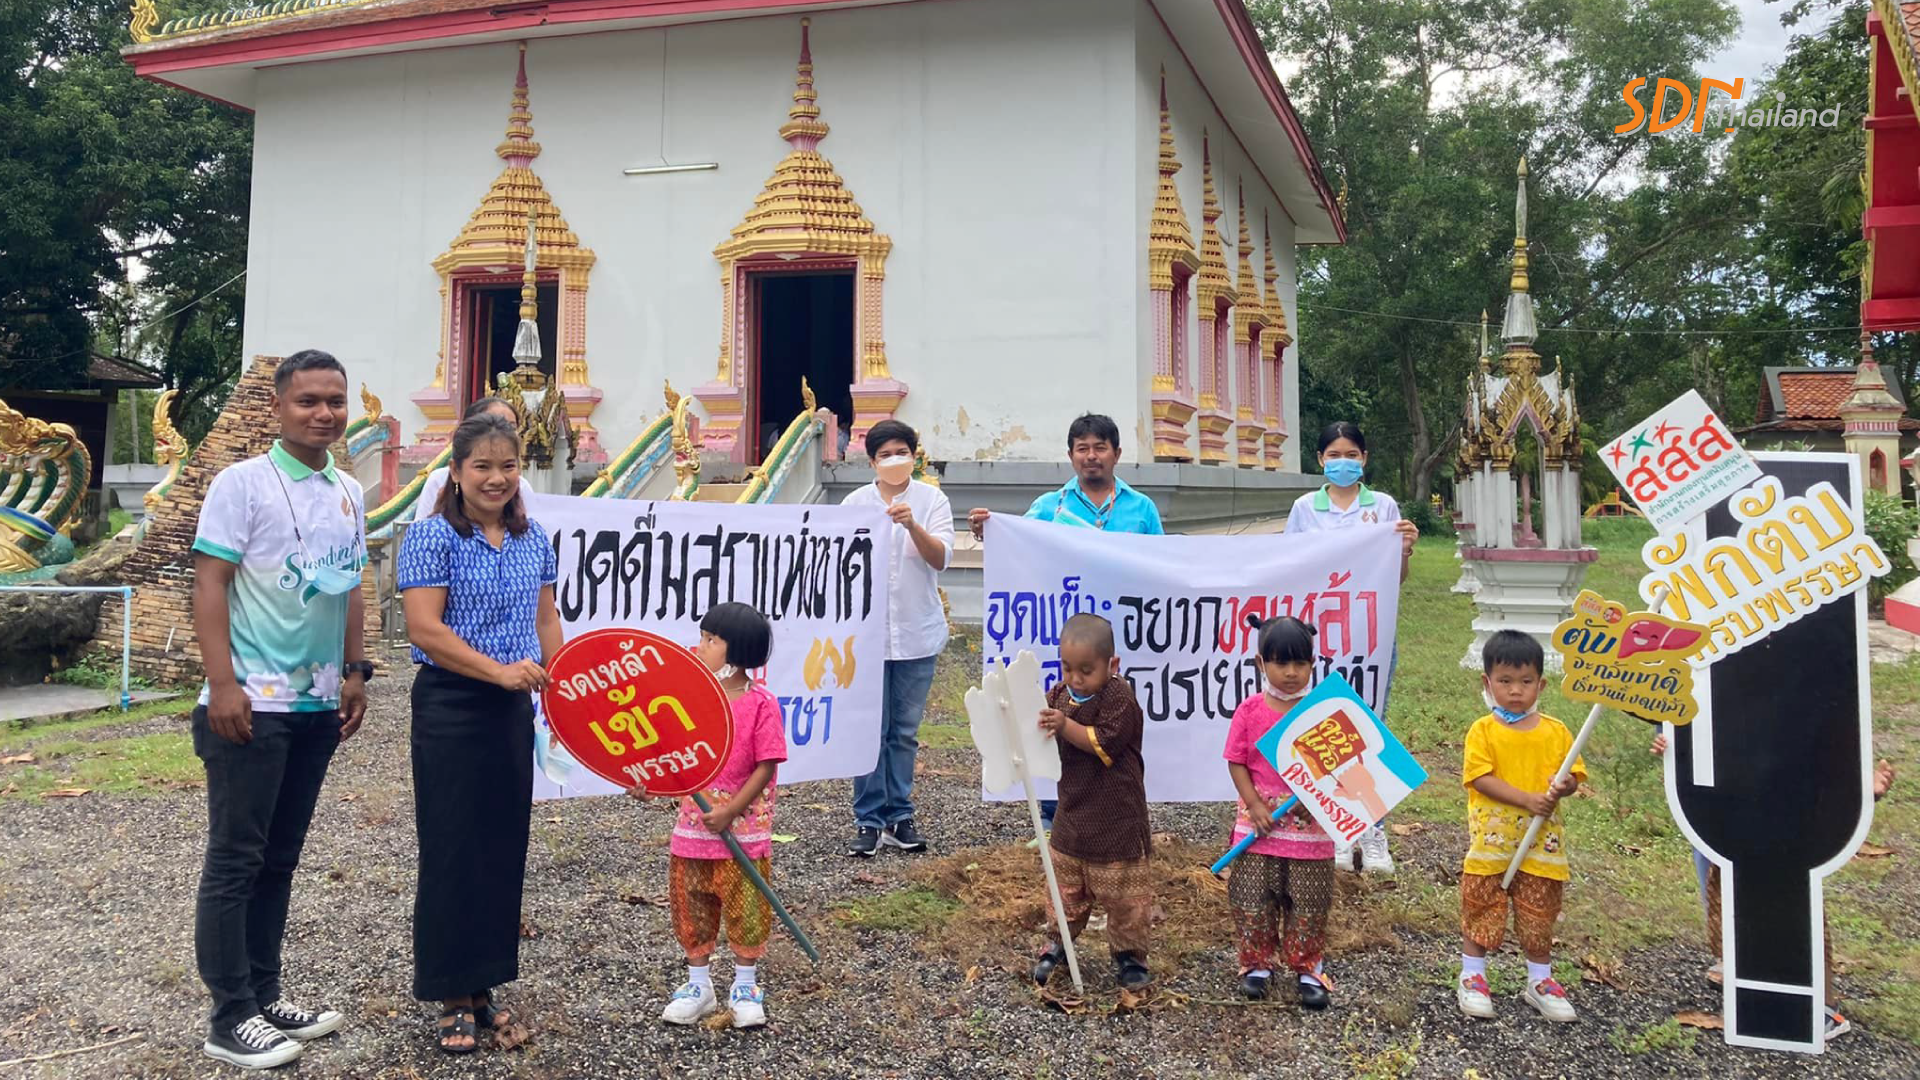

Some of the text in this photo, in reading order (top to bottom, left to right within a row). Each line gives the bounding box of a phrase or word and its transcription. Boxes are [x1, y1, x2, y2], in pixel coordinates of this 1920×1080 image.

[1626, 414, 1733, 503] สสส
[1648, 484, 1855, 622] พักตับ
[1691, 543, 1884, 661] รบพรรษา
[1562, 618, 1617, 654] ตับ
[556, 639, 665, 702] งดเหล้า
[588, 684, 698, 756] เข้า
[1298, 728, 1340, 771] แก้ว
[1319, 718, 1360, 756] คว่ำ
[622, 740, 717, 785] พรรษา
[1281, 762, 1369, 842] ครบพรรษา
